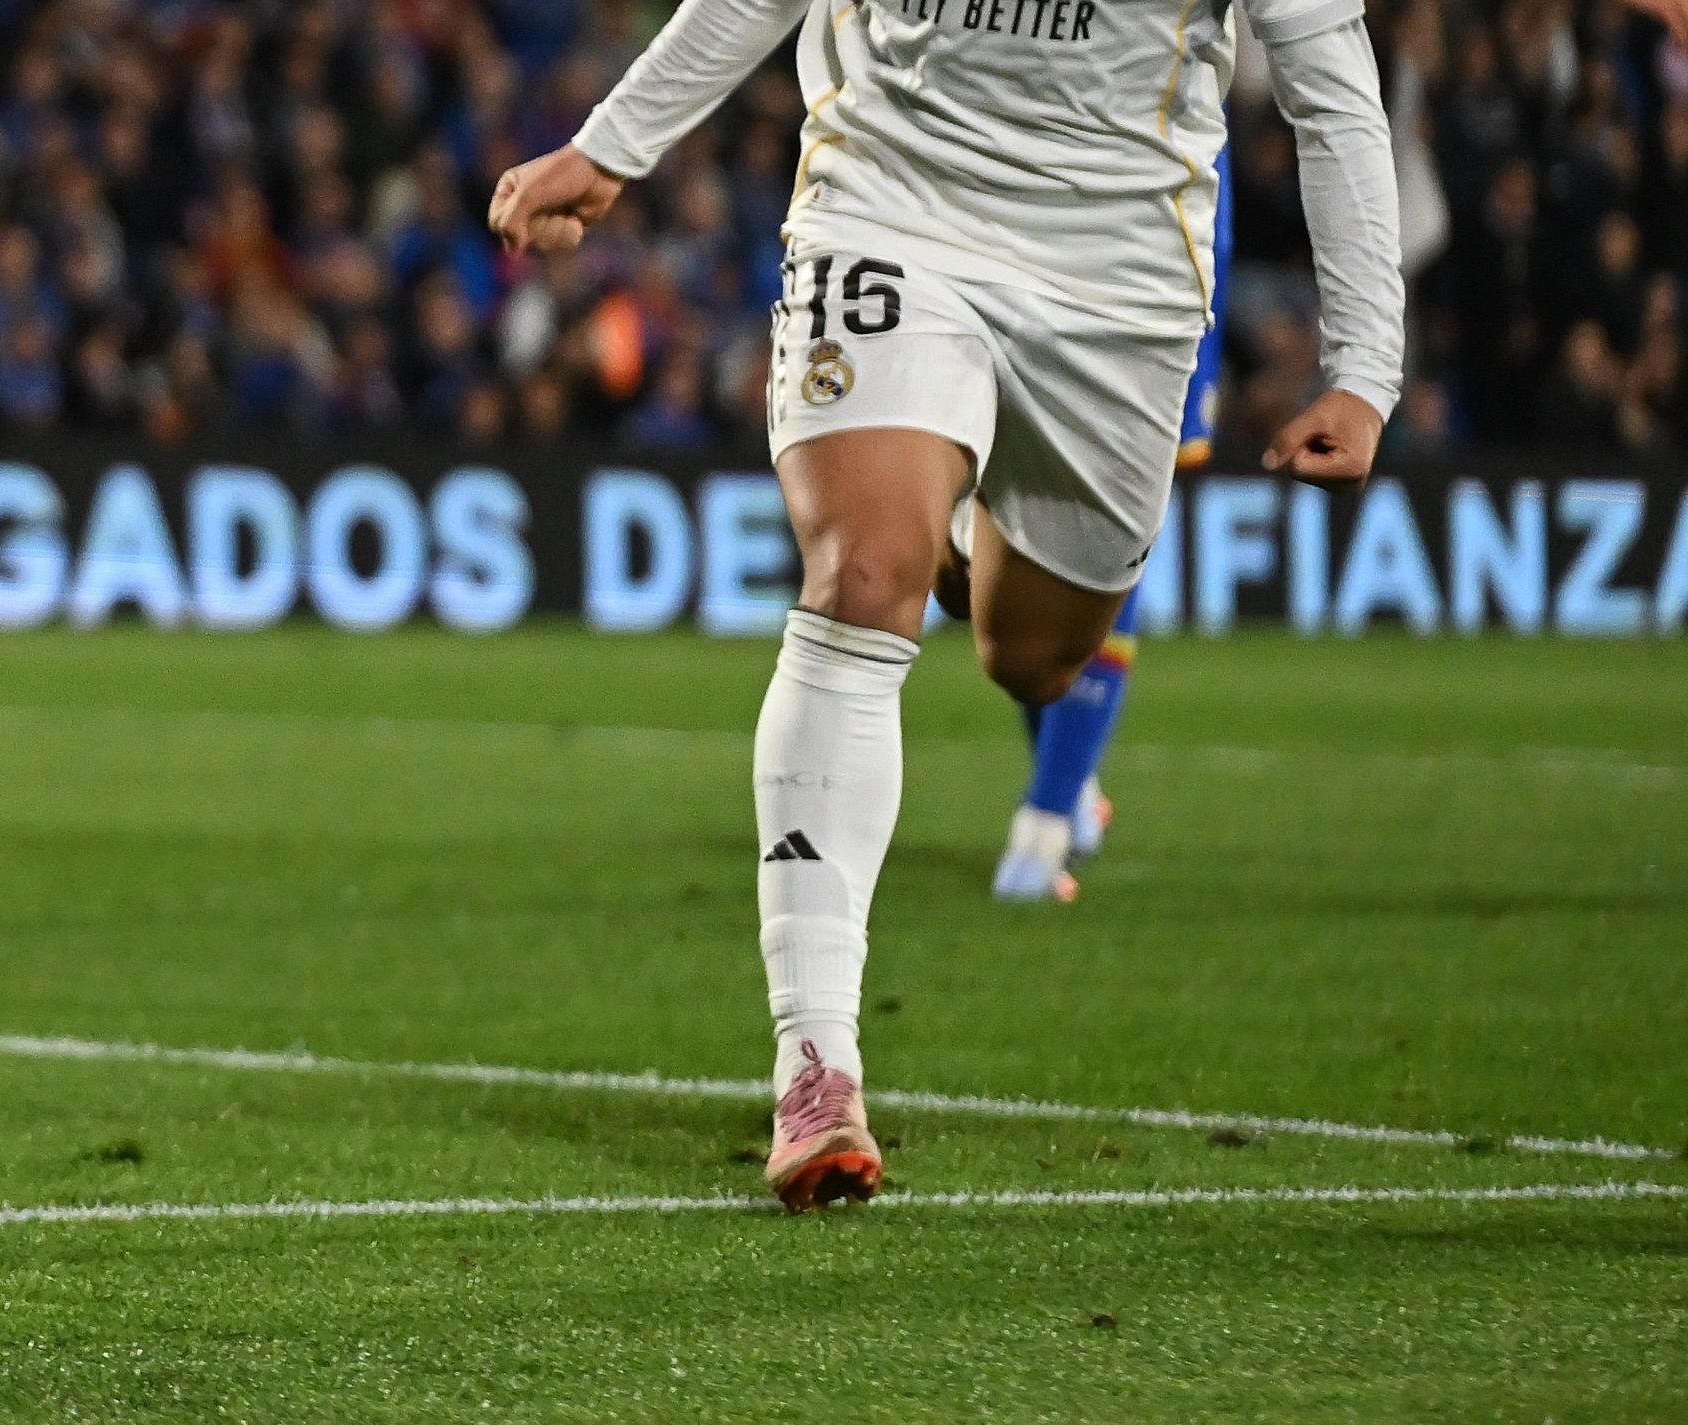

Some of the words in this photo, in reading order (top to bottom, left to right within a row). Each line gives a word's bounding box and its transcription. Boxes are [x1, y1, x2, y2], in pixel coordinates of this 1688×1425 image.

[810, 254, 905, 339] 15
[583, 466, 805, 636] DE
[921, 476, 1688, 638] FIANZ
